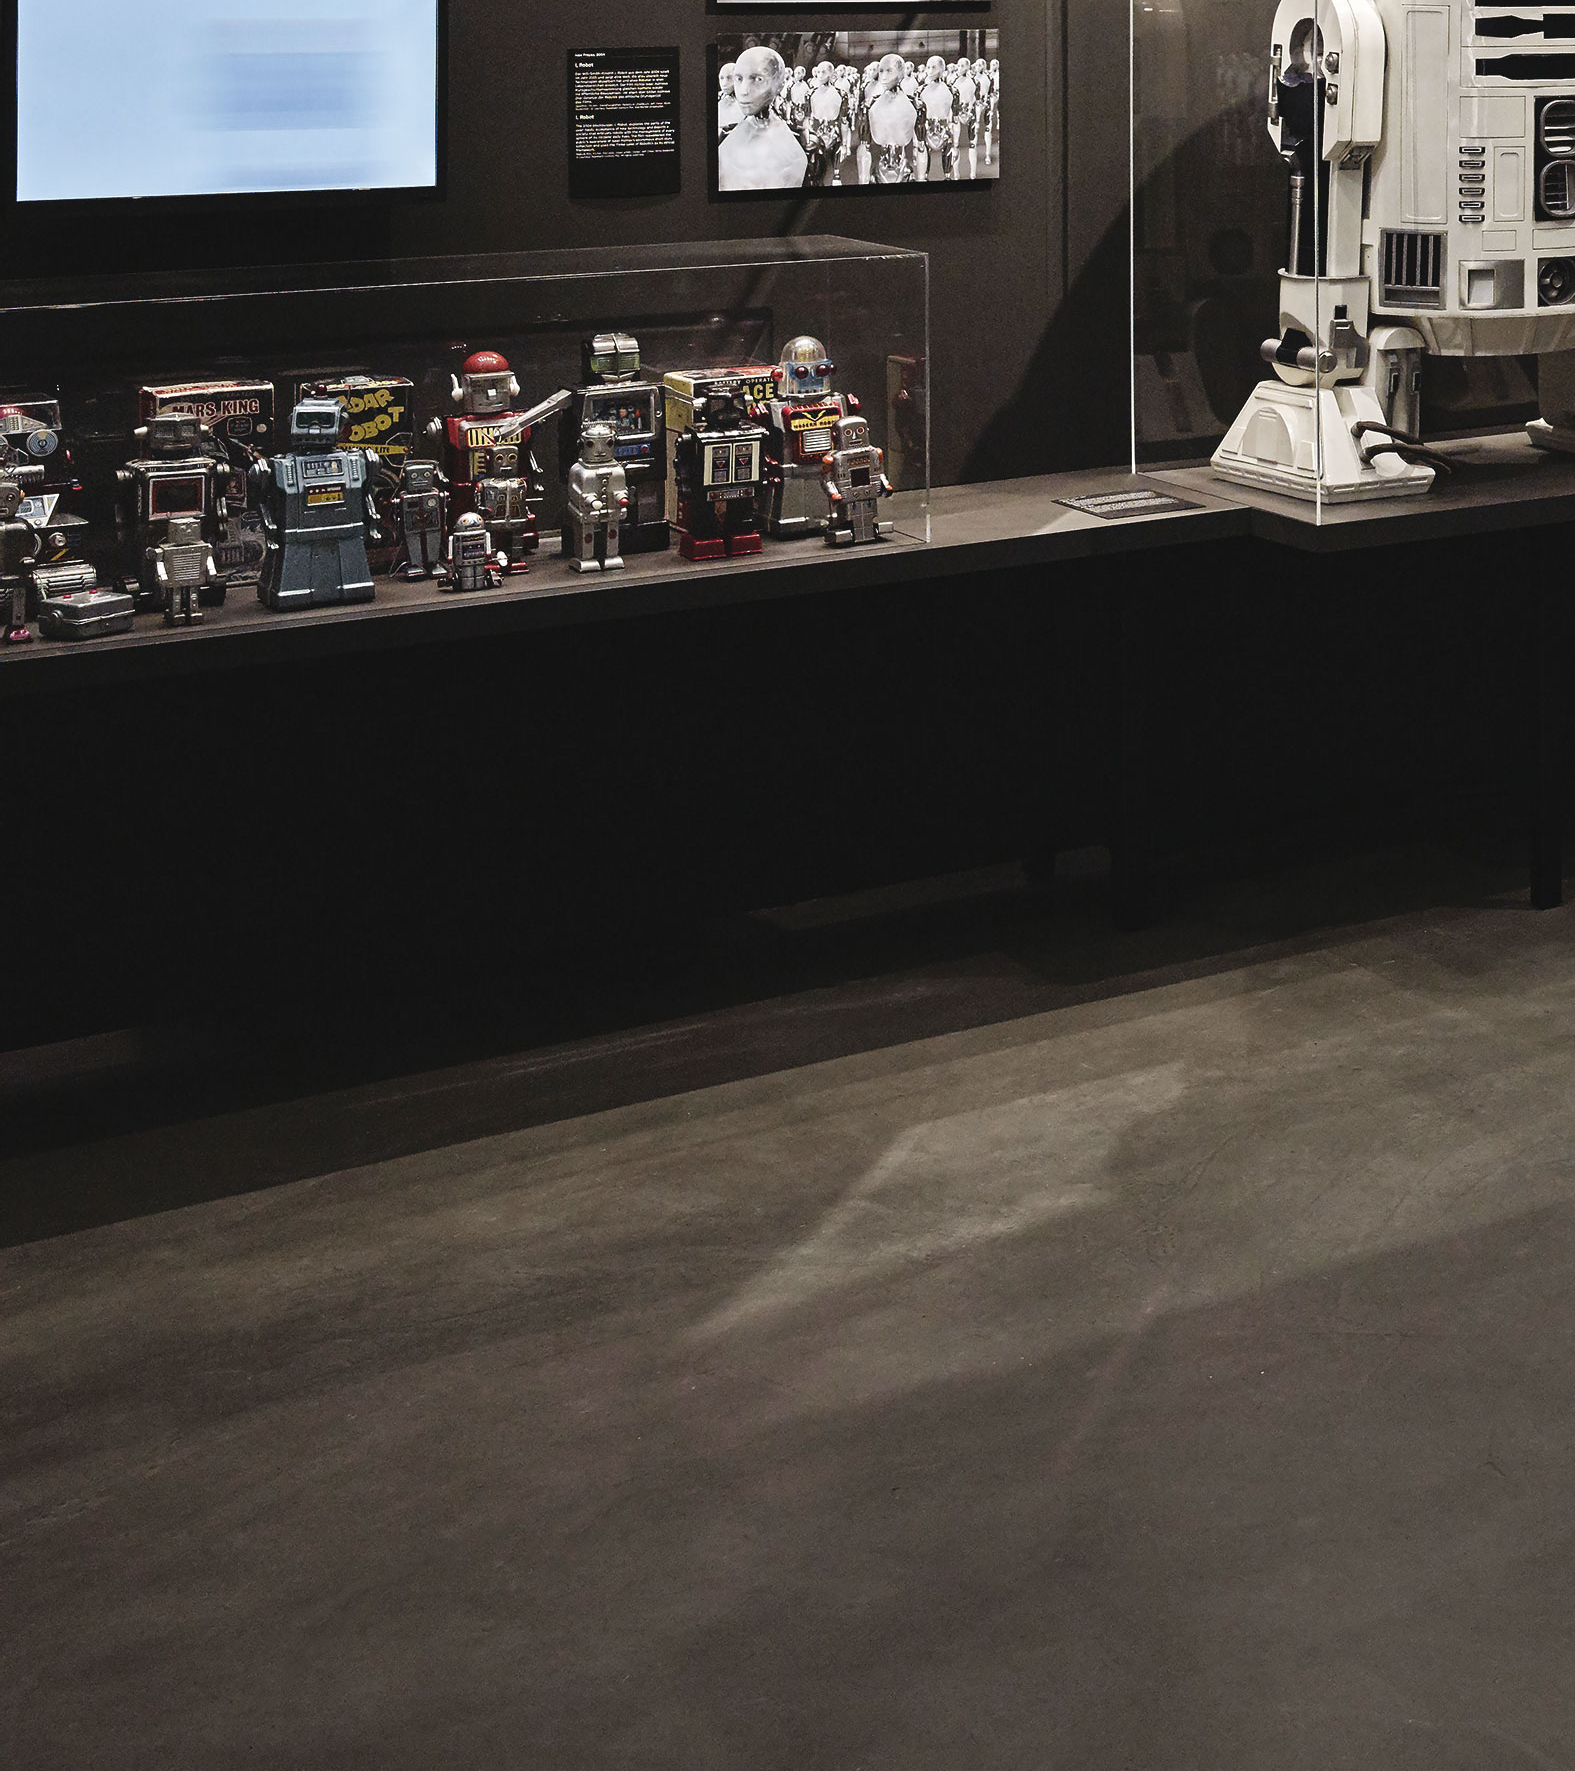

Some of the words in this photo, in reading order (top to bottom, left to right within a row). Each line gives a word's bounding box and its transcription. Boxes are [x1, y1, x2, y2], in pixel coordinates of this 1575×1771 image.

[220, 398, 260, 416] KING
[337, 389, 395, 414] ADAR
[349, 406, 404, 441] OBOT
